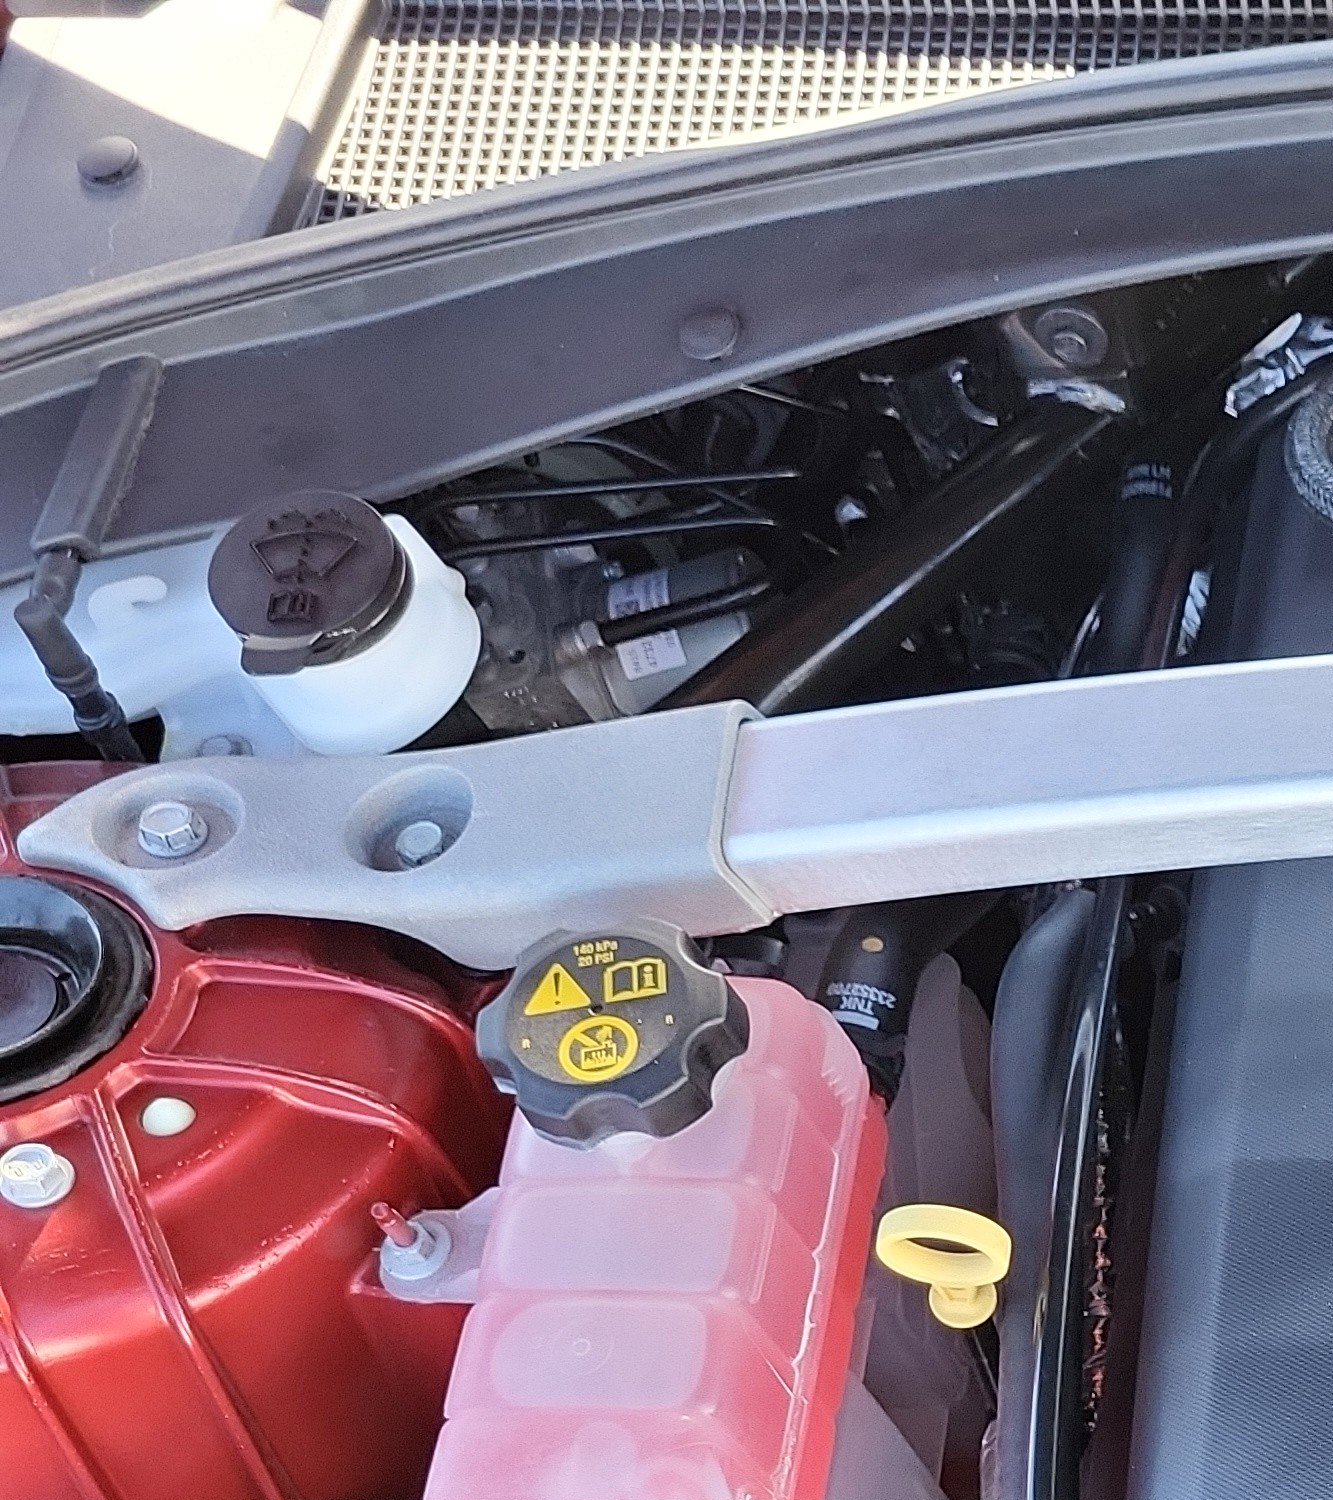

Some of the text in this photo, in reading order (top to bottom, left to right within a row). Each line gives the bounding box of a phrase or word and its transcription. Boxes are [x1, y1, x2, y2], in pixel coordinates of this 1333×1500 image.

[573, 942, 594, 956] 140
[578, 951, 614, 967] 20 PSI
[839, 996, 874, 1015] TNK
